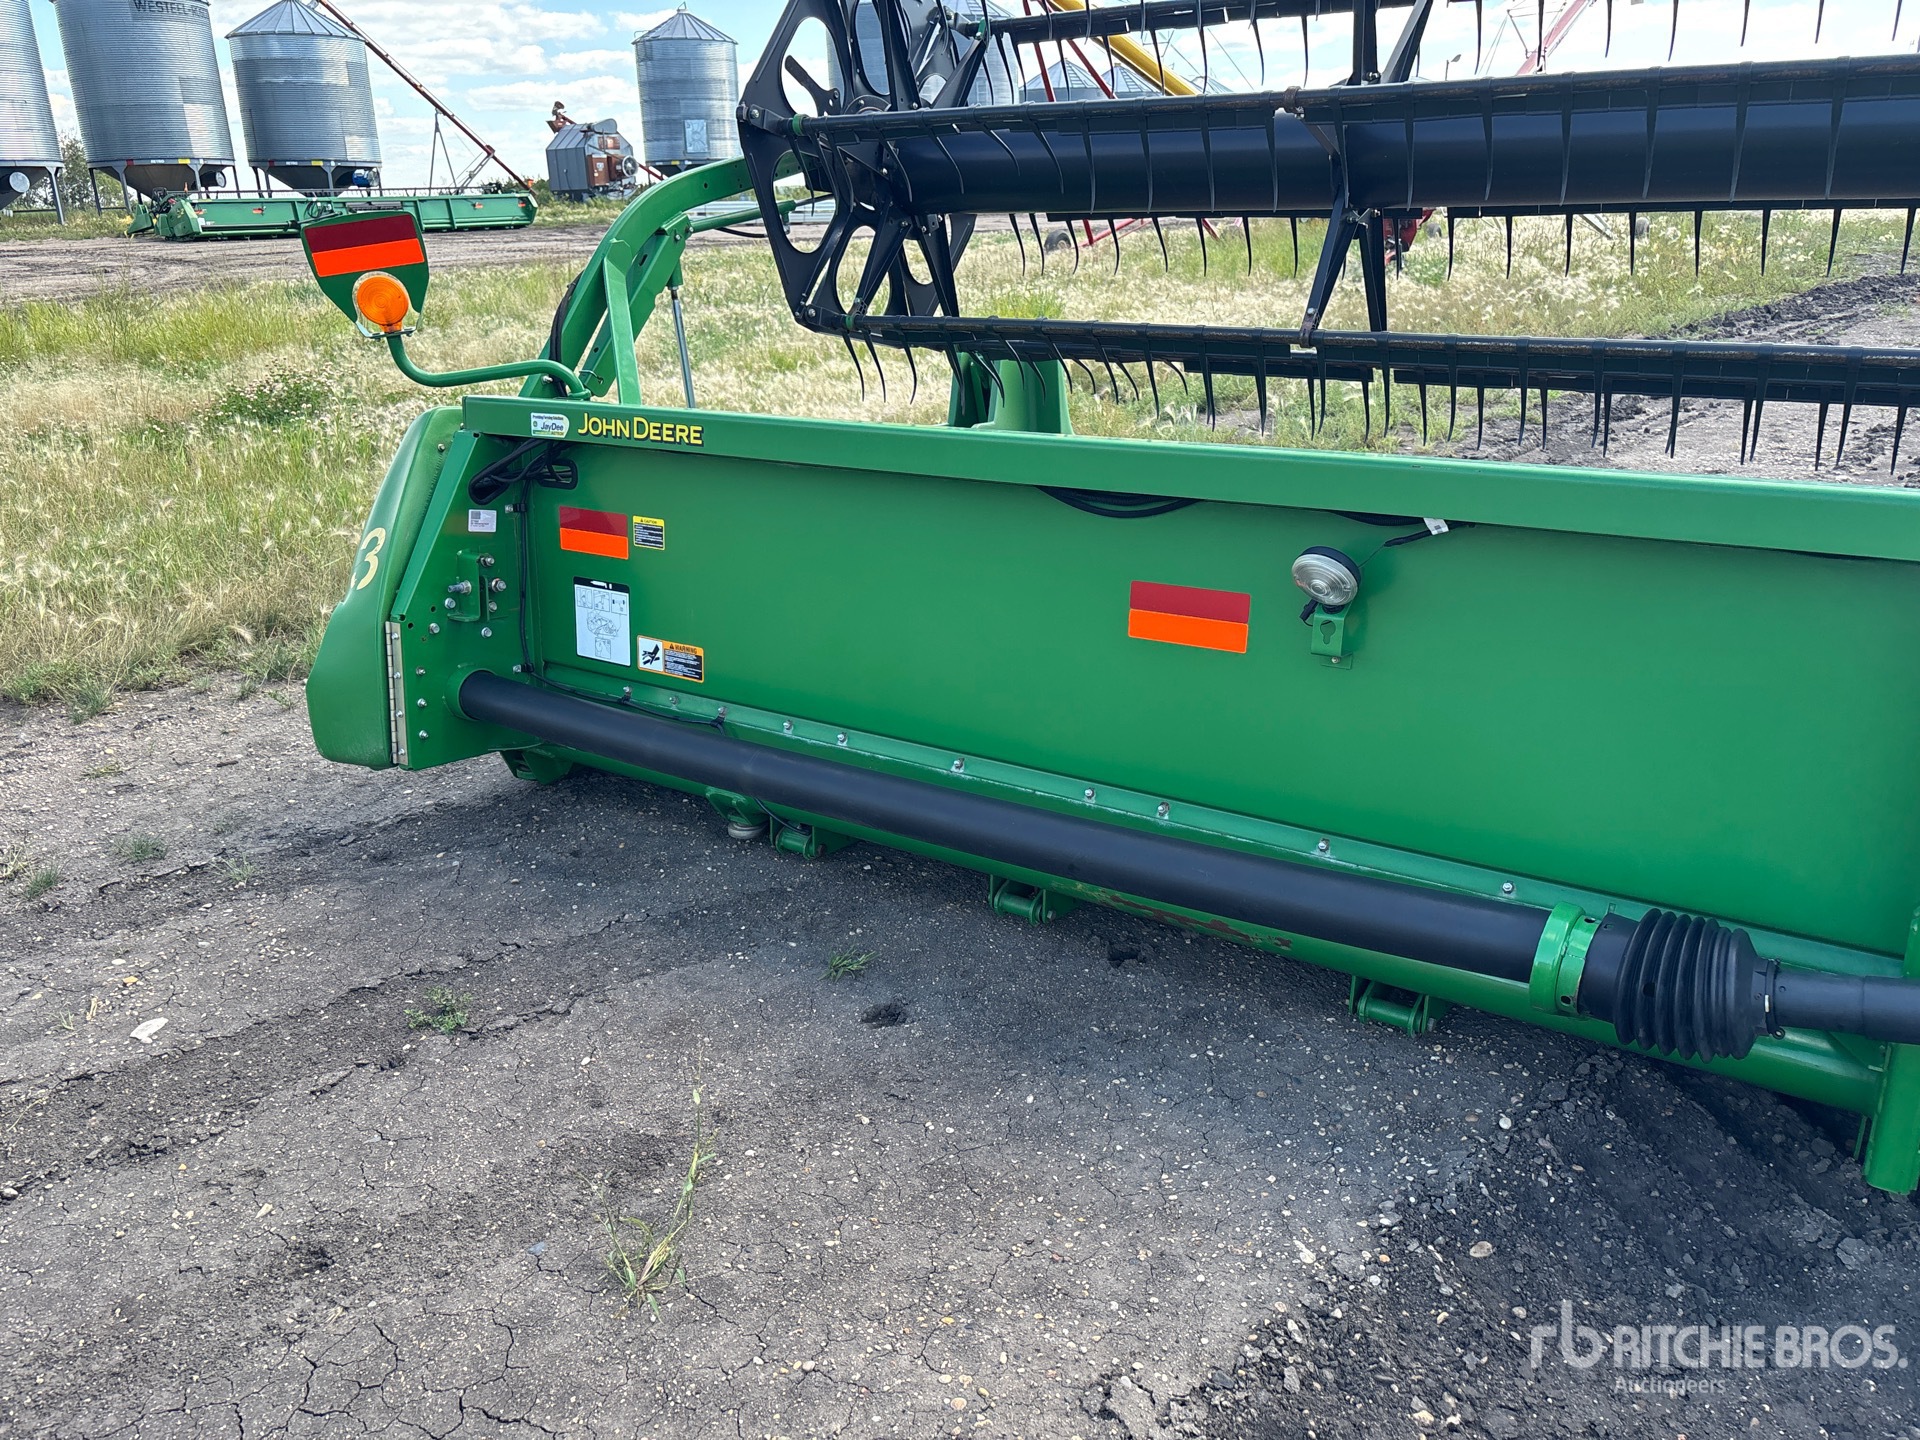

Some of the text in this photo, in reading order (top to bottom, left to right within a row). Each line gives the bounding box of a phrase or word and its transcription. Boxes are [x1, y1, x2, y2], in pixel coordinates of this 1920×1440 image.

[541, 422, 564, 432] JayDee
[577, 413, 703, 446] JOHN DEERE
[675, 644, 698, 655] WARNING
